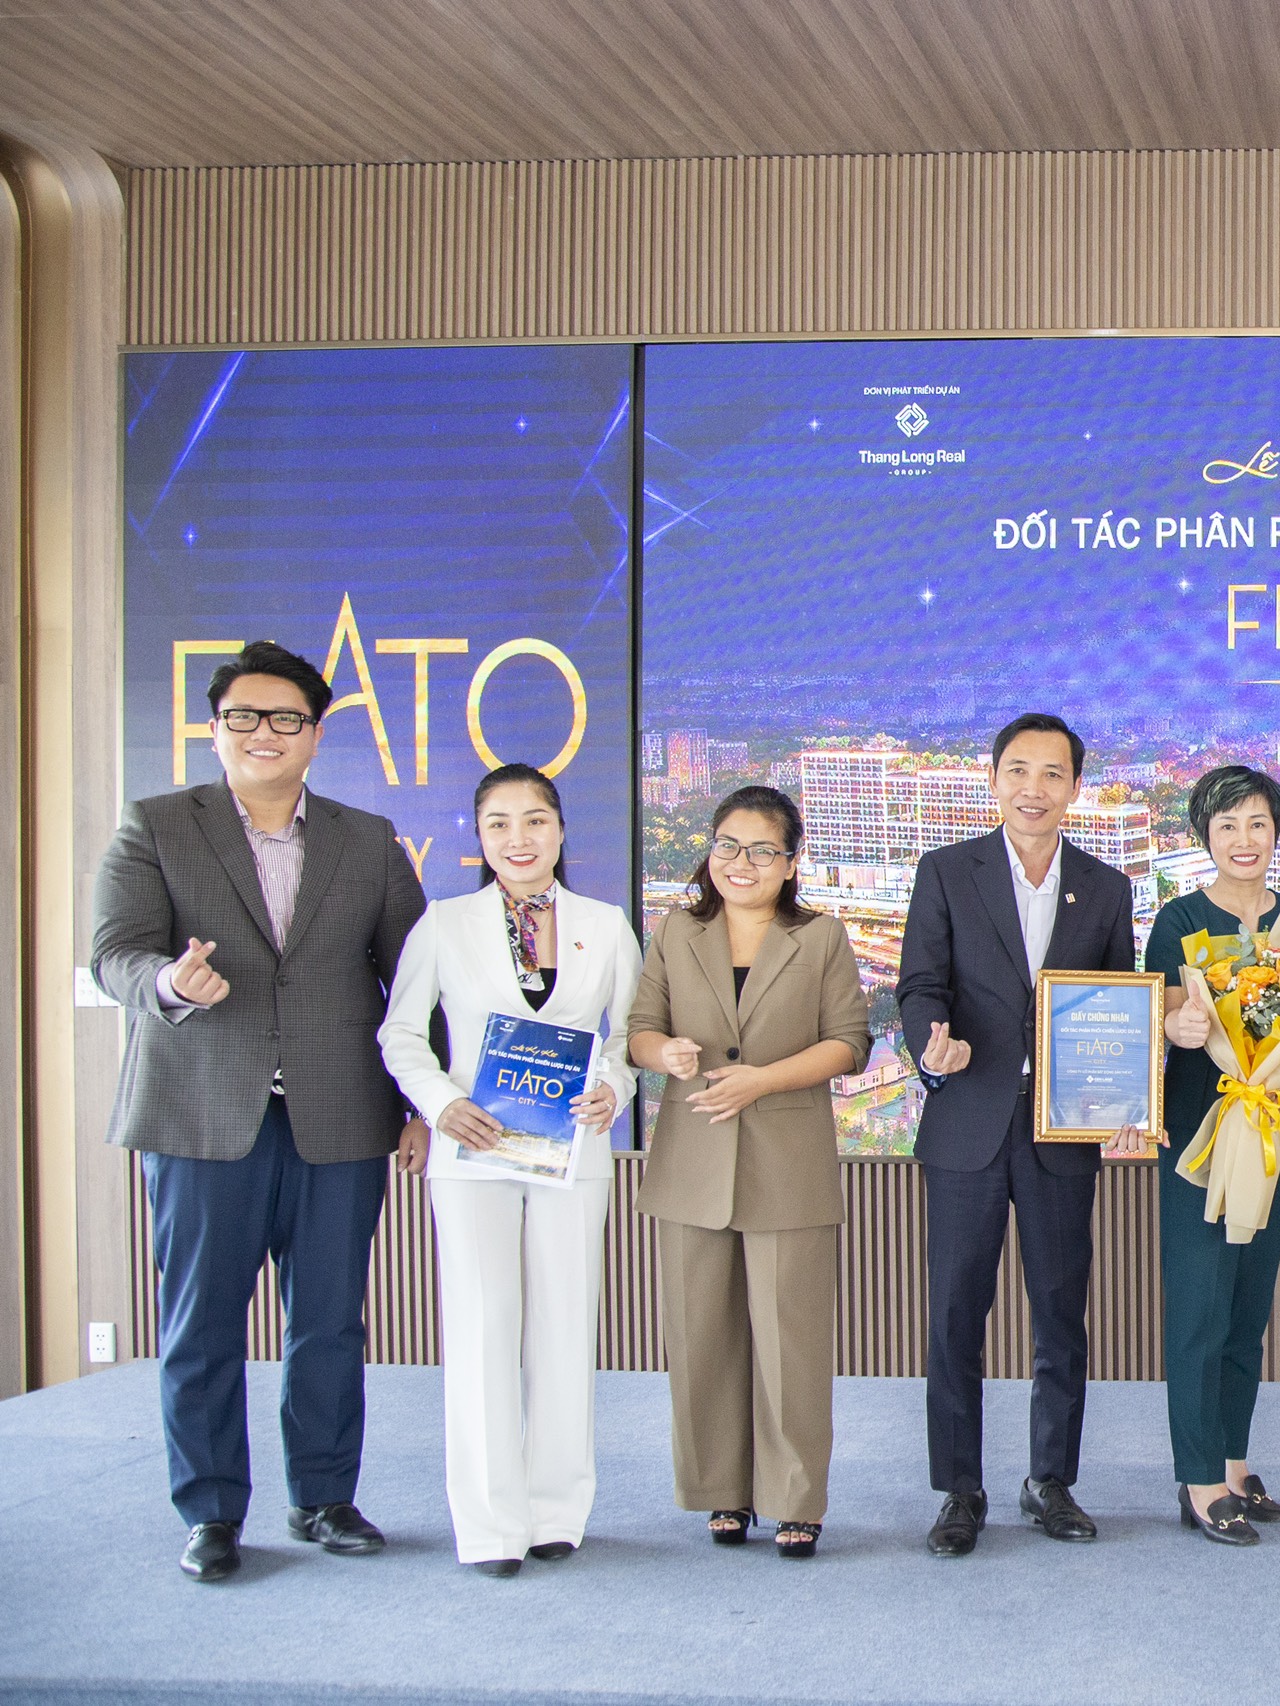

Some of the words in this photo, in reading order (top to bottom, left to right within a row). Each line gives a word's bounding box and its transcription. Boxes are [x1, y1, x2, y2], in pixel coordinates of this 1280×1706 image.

[883, 386, 891, 397] VỊ
[892, 385, 911, 395] PHÁT
[935, 386, 947, 397] DỰ
[948, 385, 961, 395] ÁN
[858, 450, 900, 466] Thang
[901, 449, 935, 466] Long
[936, 449, 966, 463] Real
[1203, 441, 1280, 484] Lễ
[994, 509, 1057, 549] ĐỐI
[1071, 510, 1141, 549] TÁC
[1155, 511, 1255, 548] PHÂN
[173, 591, 588, 786] FATO
[1071, 1010, 1086, 1022] GIẤY
[1087, 1011, 1109, 1022] CHỨNG
[1110, 1012, 1130, 1024] NHẬN
[1076, 1038, 1124, 1056] FIATO
[496, 1068, 564, 1099] FIATO
[518, 1097, 537, 1106] CITY
